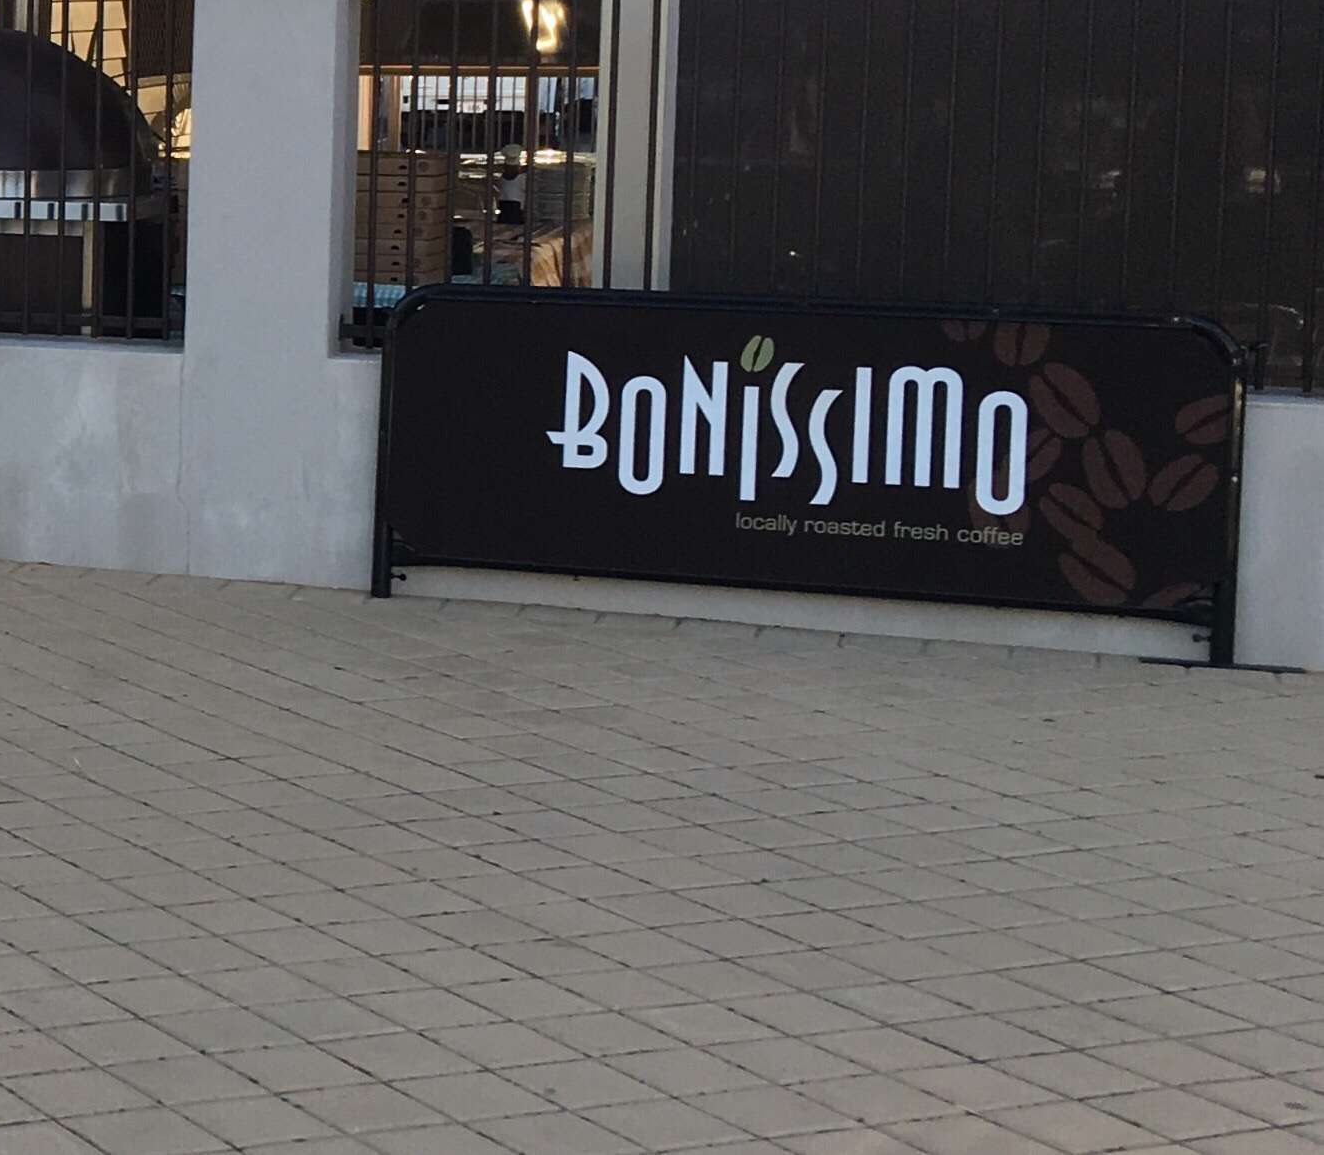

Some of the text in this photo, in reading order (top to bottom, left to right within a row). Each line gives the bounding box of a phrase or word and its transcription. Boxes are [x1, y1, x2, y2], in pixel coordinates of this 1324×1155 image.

[736, 512, 1023, 545] locally roasted fresh coffee
